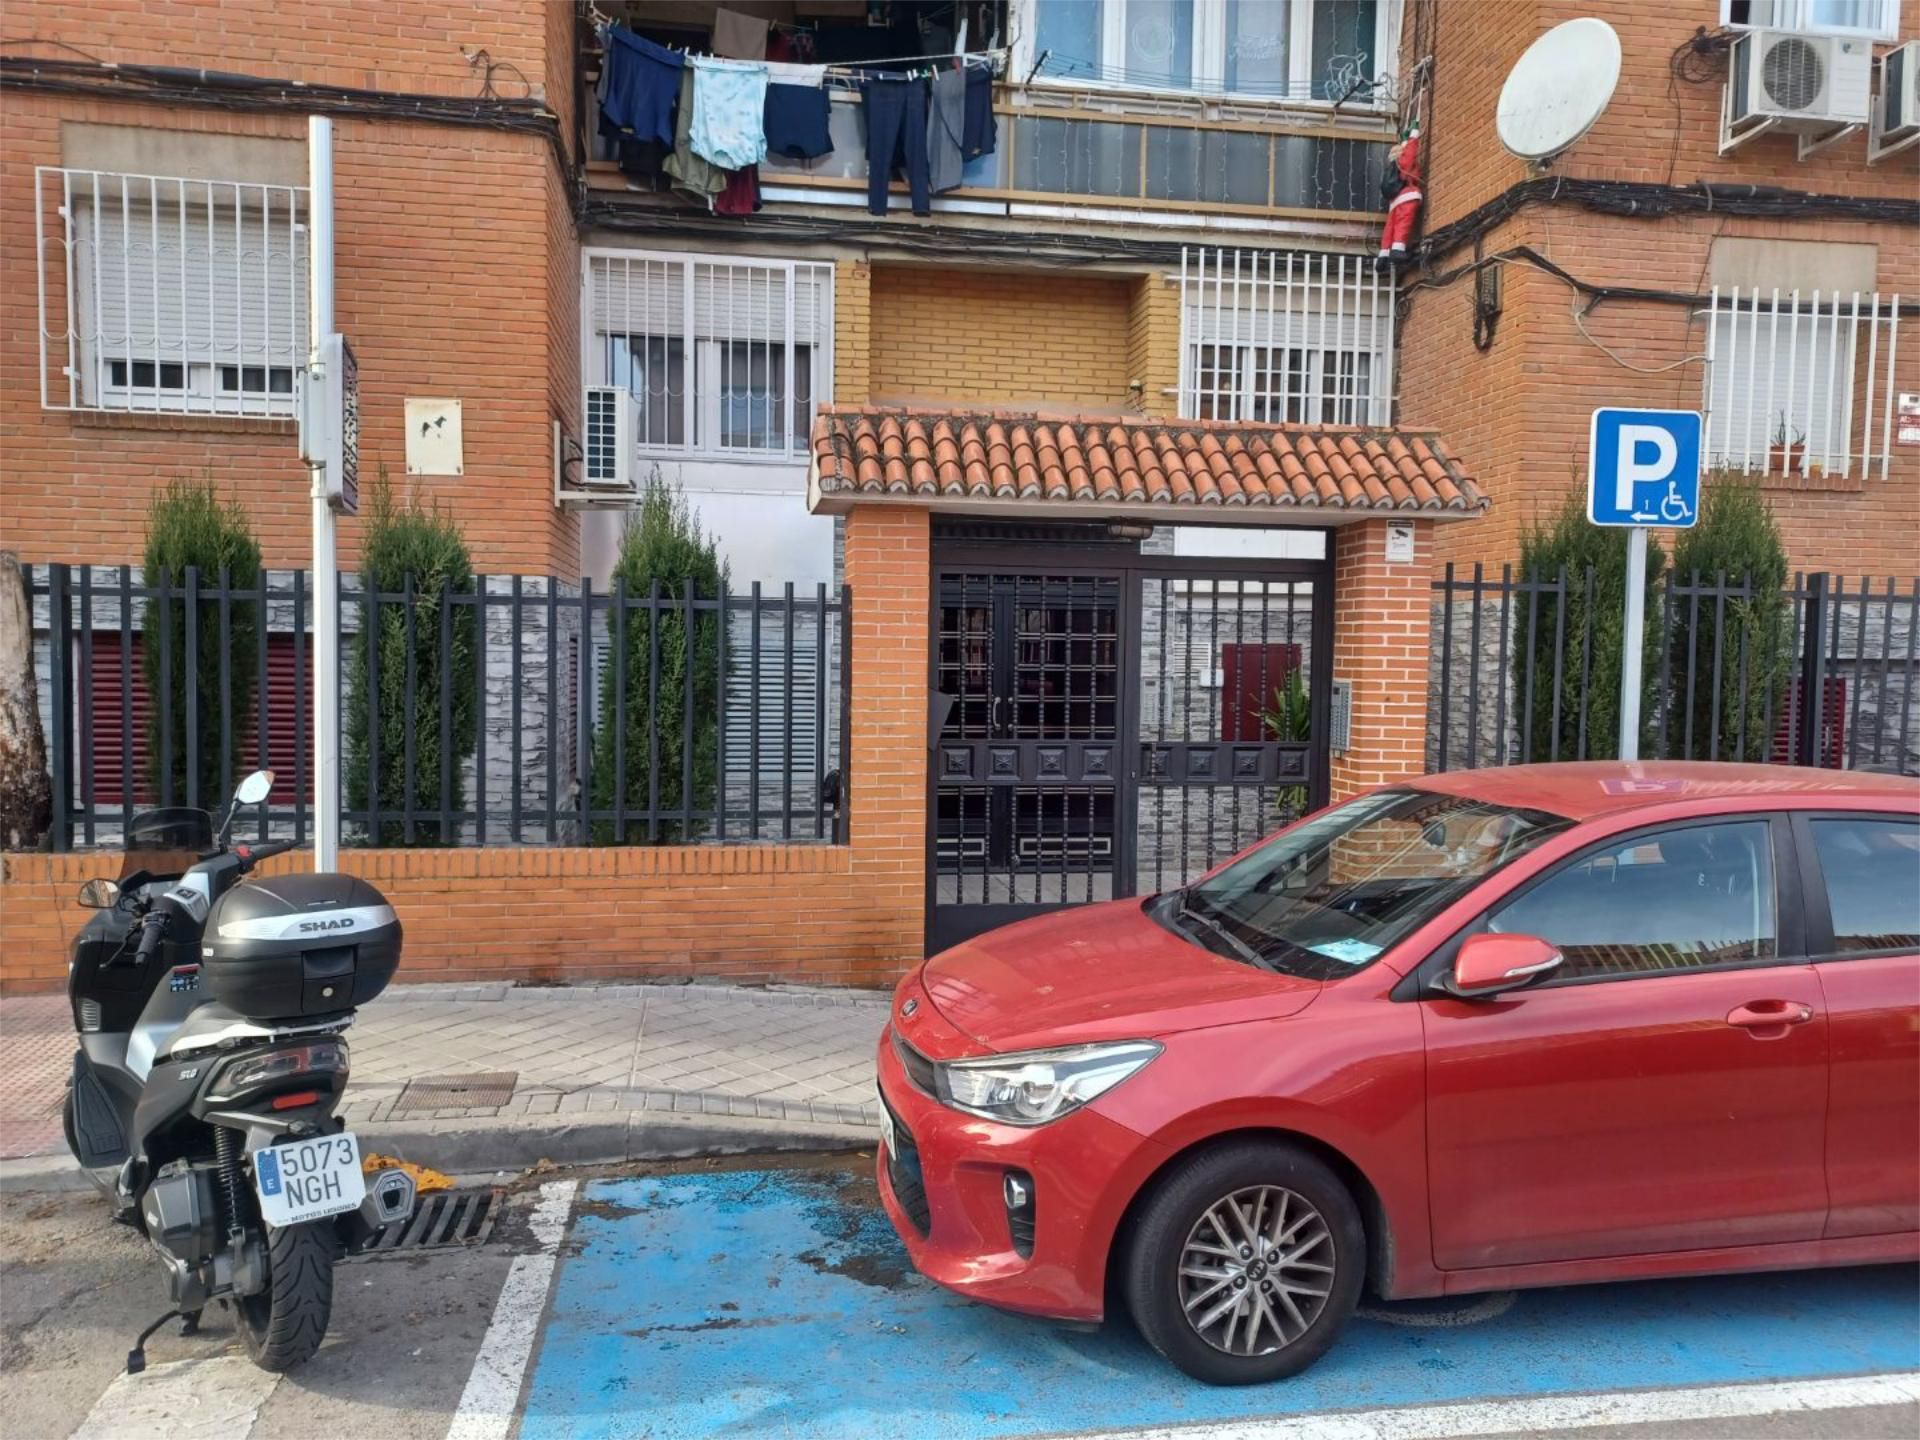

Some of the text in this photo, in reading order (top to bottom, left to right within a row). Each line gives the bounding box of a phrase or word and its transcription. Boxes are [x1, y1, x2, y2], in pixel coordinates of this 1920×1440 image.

[1615, 423, 1678, 511] P
[299, 918, 355, 932] SHAD
[280, 1139, 353, 1176] 5073
[266, 1179, 275, 1190] E
[286, 1170, 341, 1208] NGH
